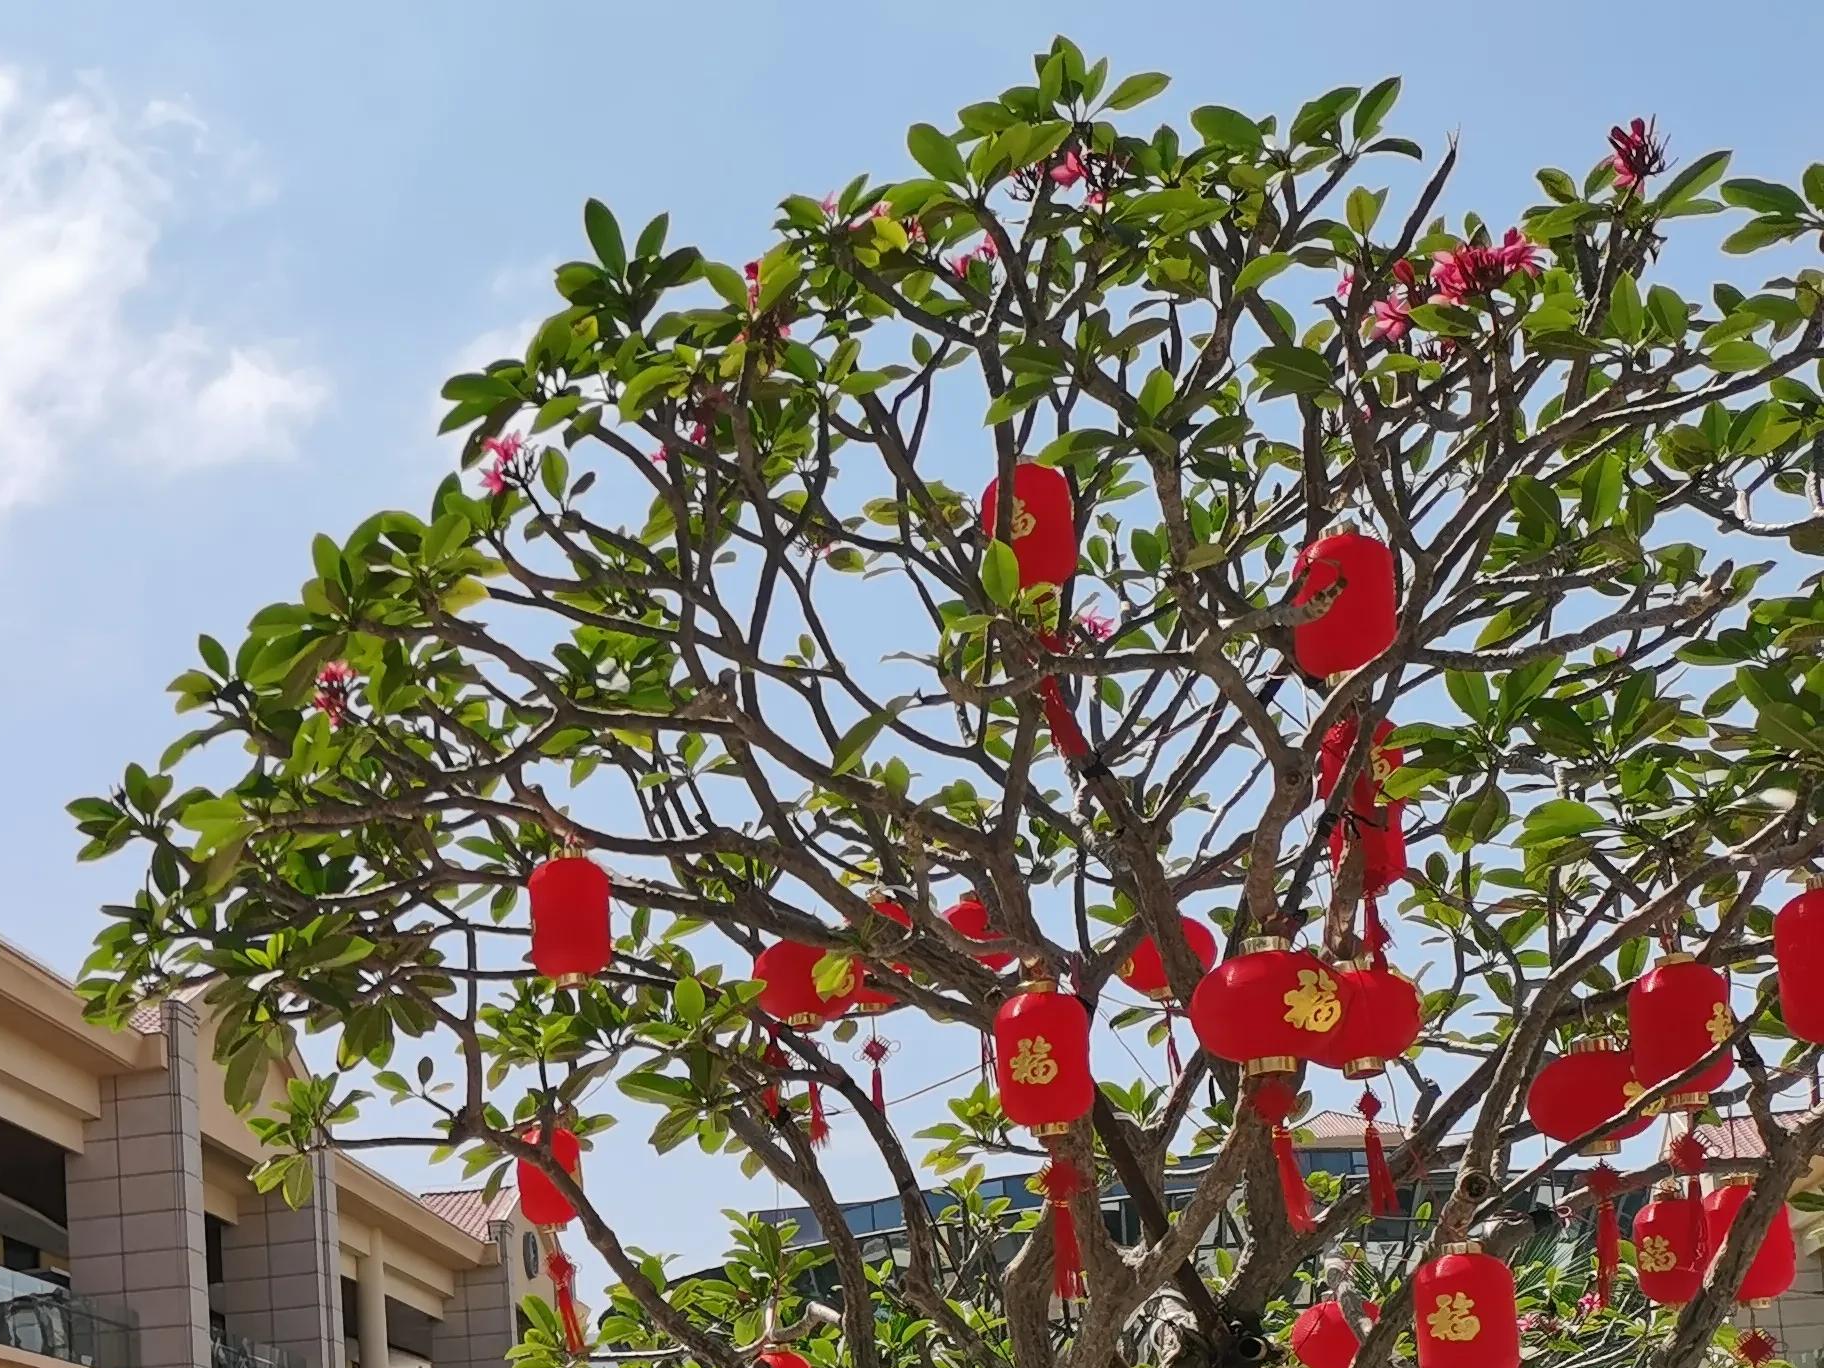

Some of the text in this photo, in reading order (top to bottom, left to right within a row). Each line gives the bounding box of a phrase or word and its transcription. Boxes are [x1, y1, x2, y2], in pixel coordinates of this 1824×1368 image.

[1283, 968, 1341, 1032] 福
[1010, 1035, 1058, 1085] 福
[1639, 1235, 1677, 1272] 福
[1427, 1292, 1480, 1341] 福
